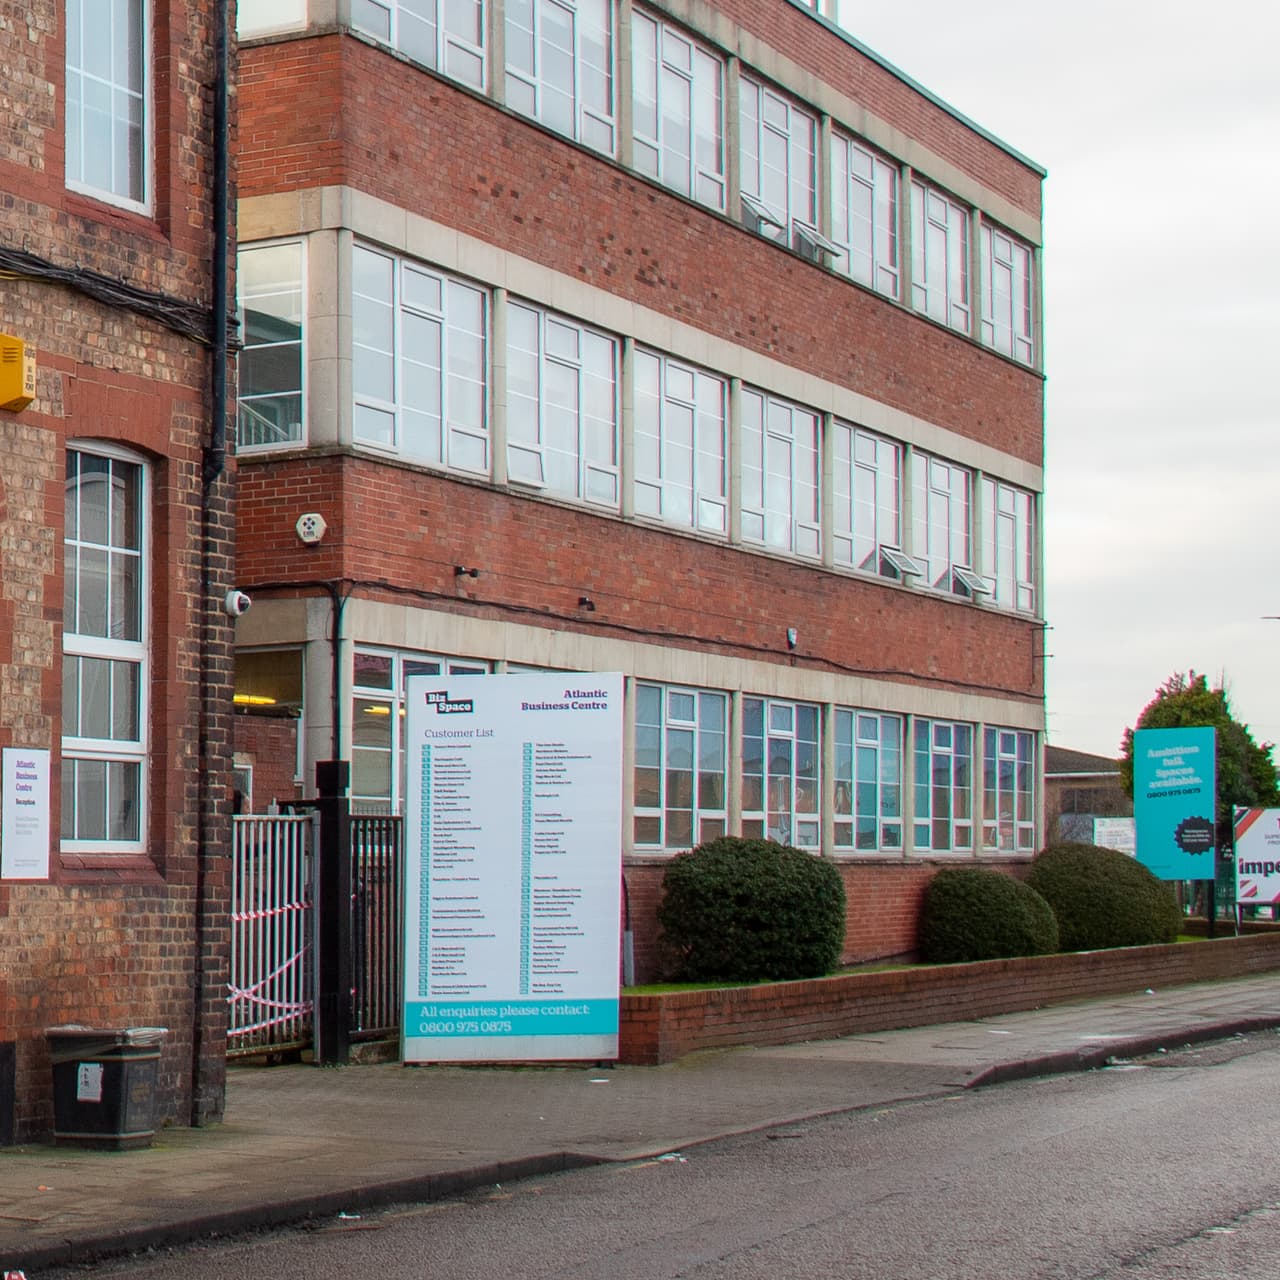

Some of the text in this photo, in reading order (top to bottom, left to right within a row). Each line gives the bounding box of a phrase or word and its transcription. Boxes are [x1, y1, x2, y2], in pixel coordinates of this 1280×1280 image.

[564, 688, 608, 699] Atlantic
[439, 702, 472, 713] Space
[521, 701, 608, 711] Business Centre
[424, 728, 494, 738] Customer List
[420, 1006, 437, 1017] All
[439, 1005, 497, 1018] enquiries
[499, 1004, 539, 1018] please
[419, 1021, 512, 1034] 0800 975 0875
